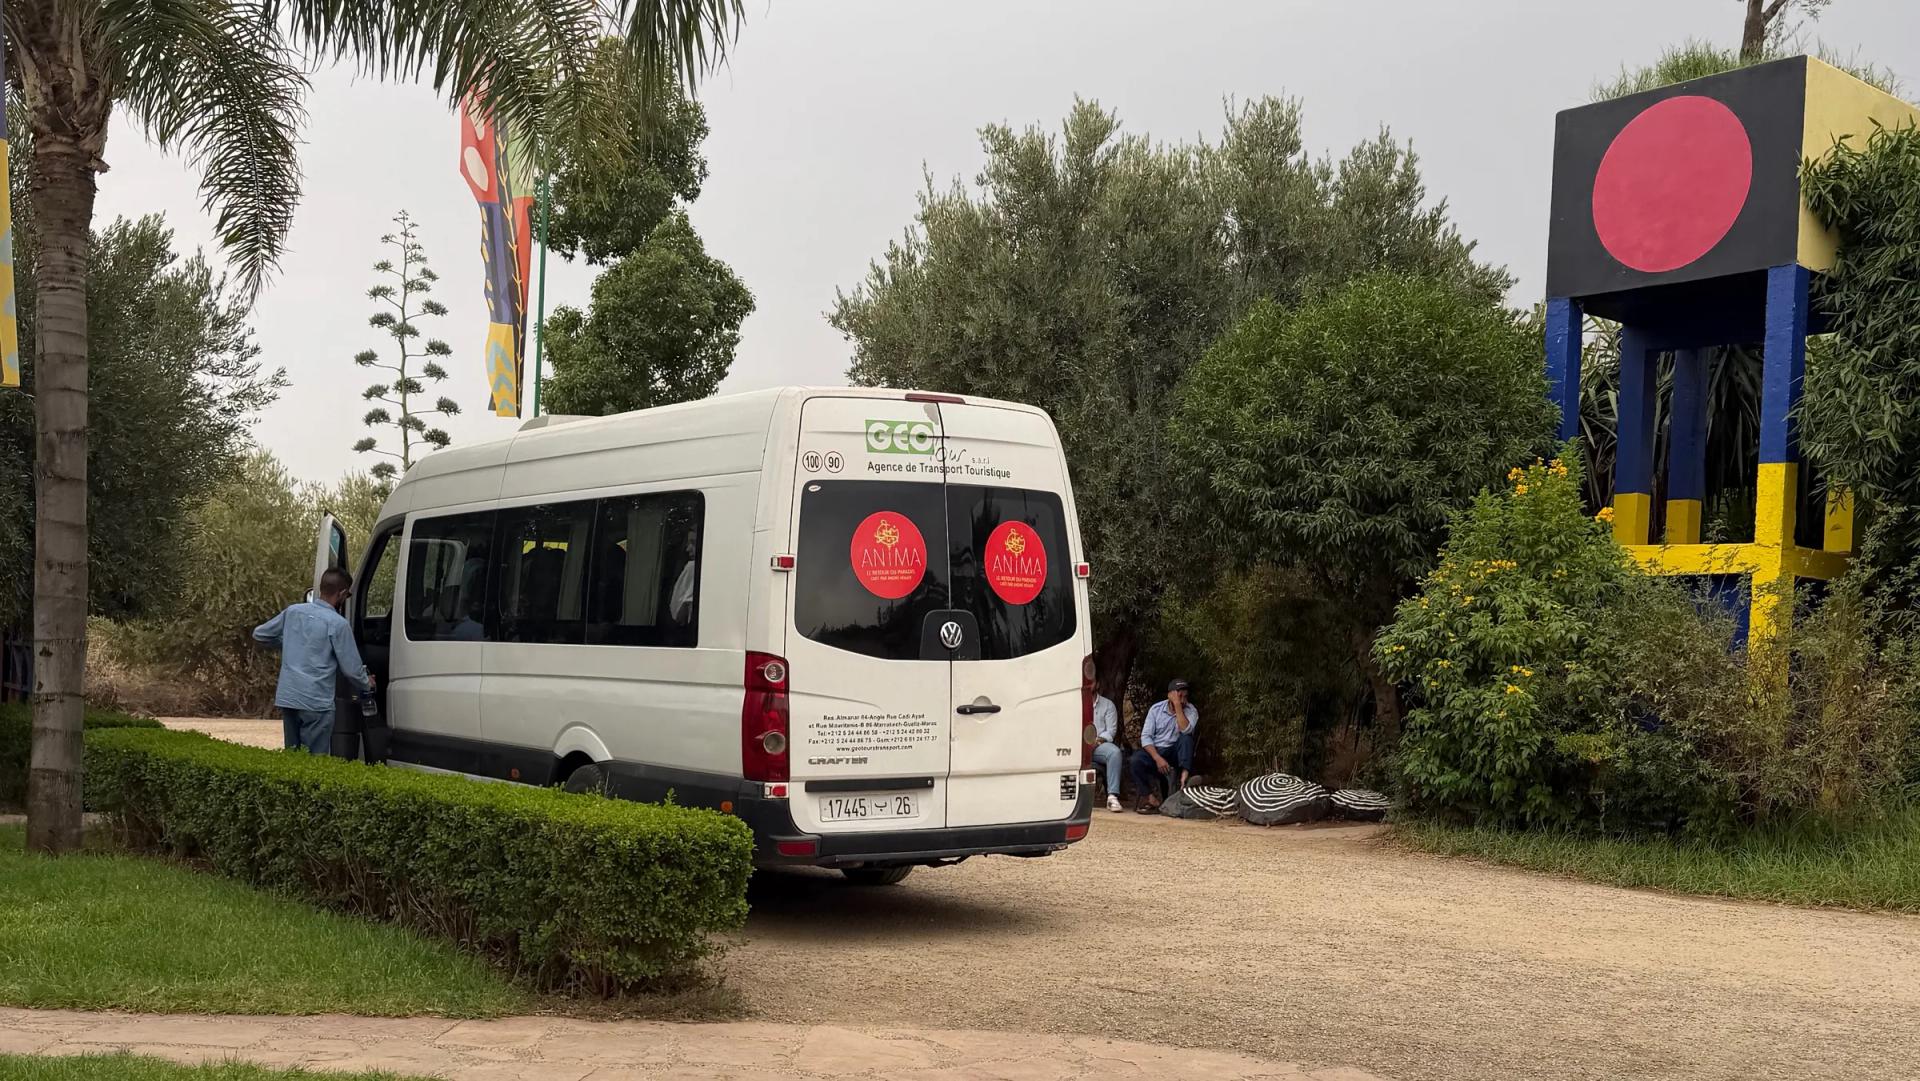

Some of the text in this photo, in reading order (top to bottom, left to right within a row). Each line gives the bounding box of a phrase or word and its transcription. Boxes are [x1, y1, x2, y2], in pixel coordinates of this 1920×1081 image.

[867, 421, 935, 451] GEO
[805, 455, 820, 469] 100
[828, 456, 840, 469] 90
[868, 461, 1011, 479] Agence de Transport Touristique
[862, 547, 922, 568] ANIMA
[992, 554, 1042, 576] ANIMA
[808, 757, 868, 765] CRAFTER
[1056, 748, 1072, 756] TDI
[828, 796, 910, 818] 17445 ب 26
